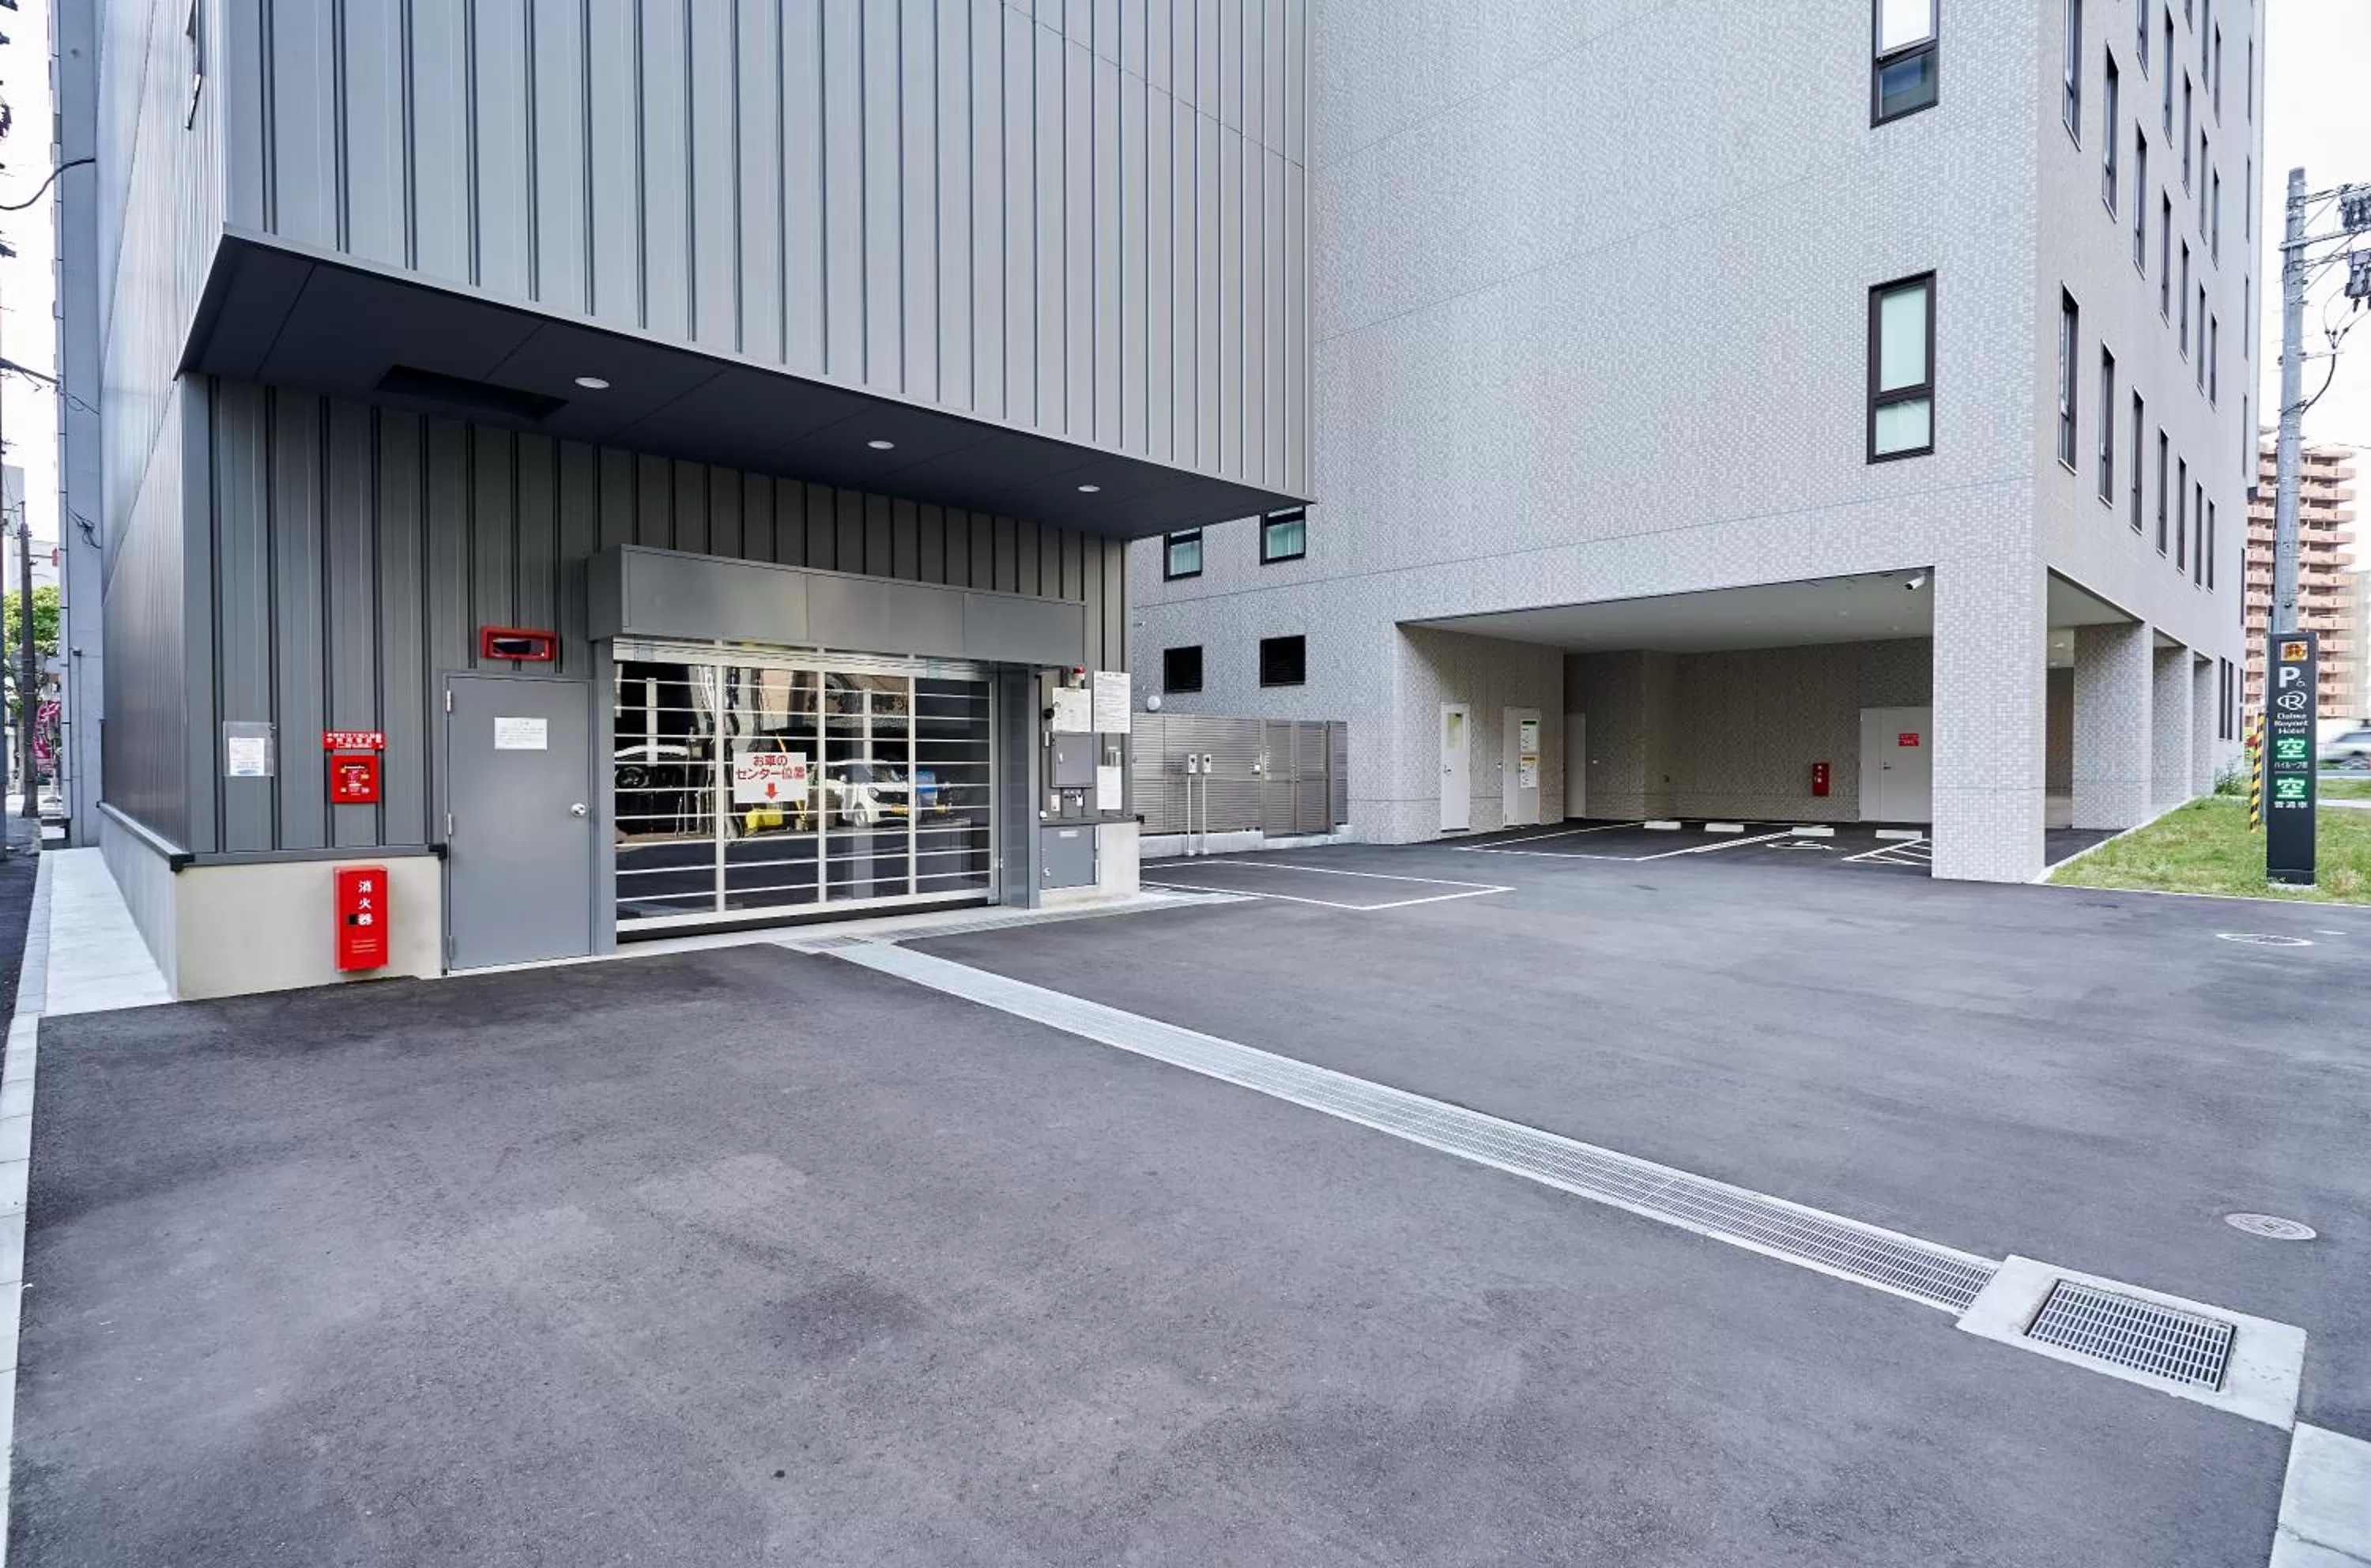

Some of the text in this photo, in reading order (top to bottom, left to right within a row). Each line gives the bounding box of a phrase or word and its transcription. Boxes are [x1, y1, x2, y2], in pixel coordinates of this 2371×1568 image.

[2279, 666, 2301, 688] P
[2277, 737, 2305, 759] 空
[752, 753, 788, 767] お車の
[736, 766, 805, 780] センター位置
[2277, 777, 2305, 799] 空
[358, 879, 374, 925] 消火器
